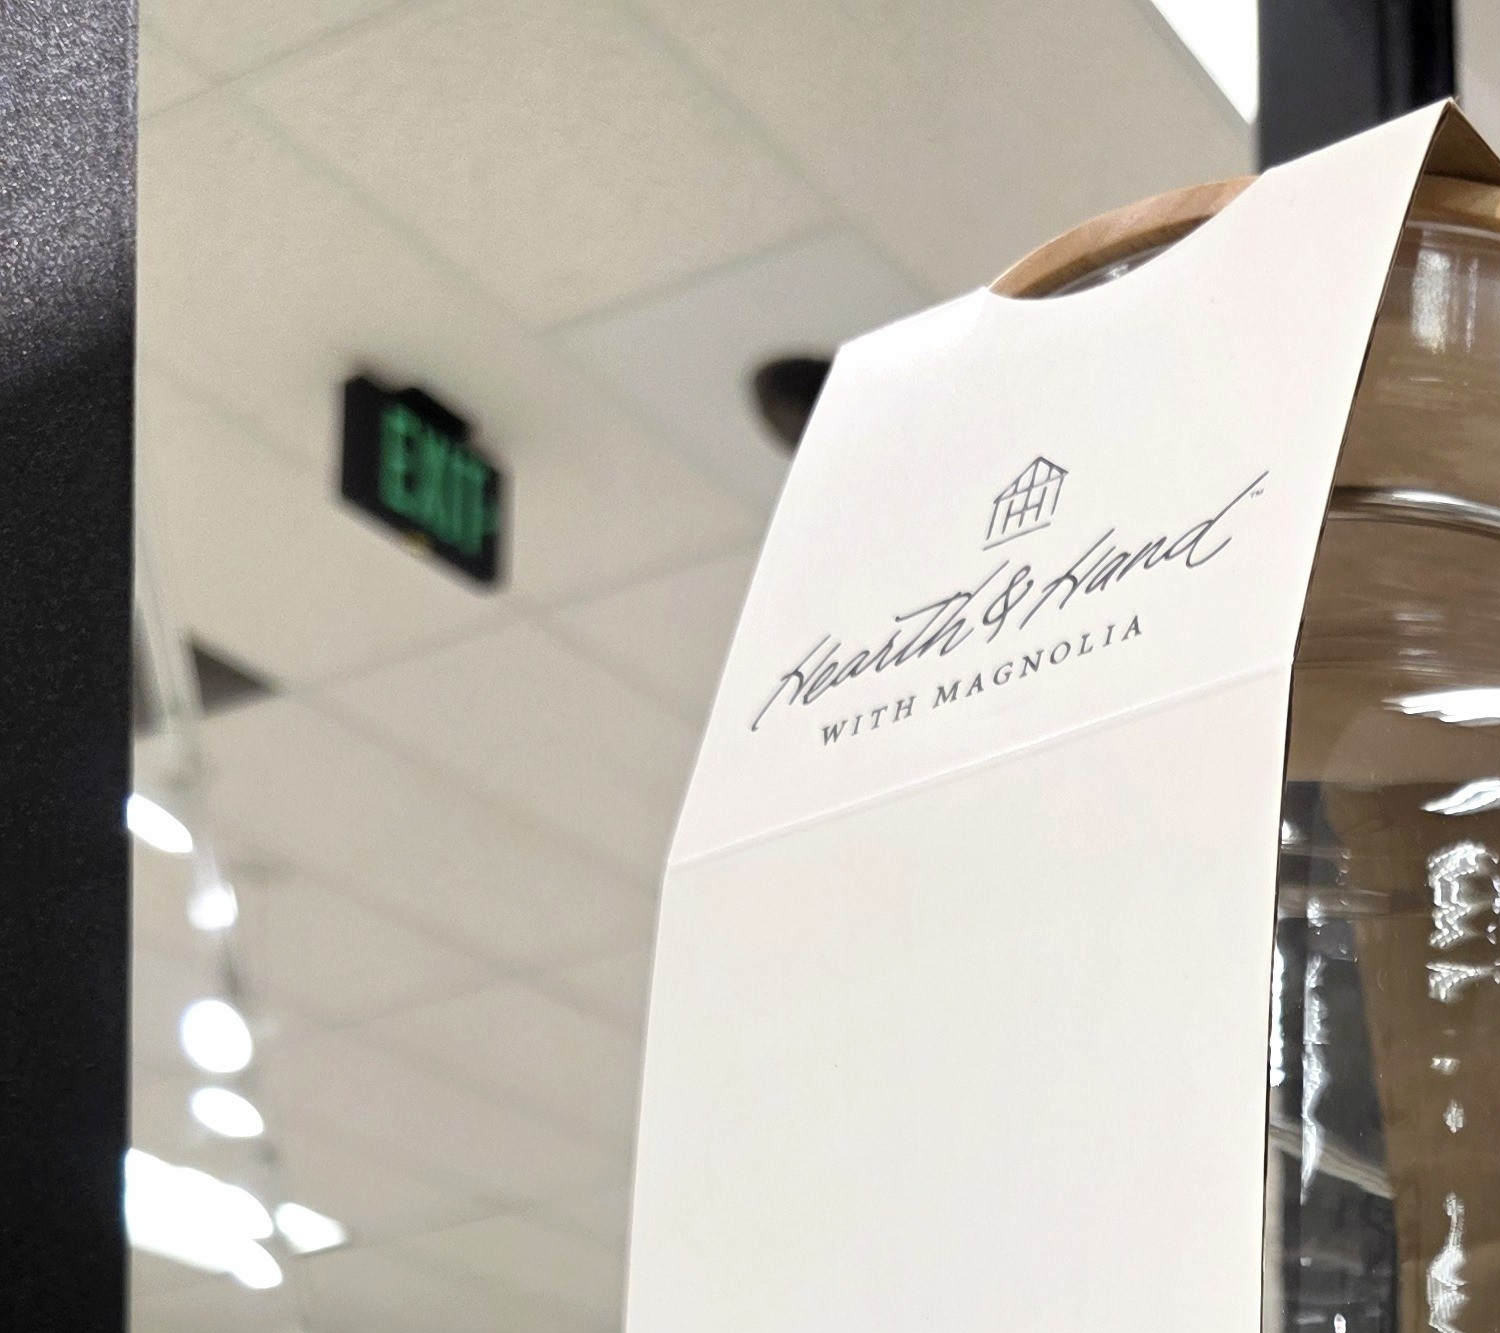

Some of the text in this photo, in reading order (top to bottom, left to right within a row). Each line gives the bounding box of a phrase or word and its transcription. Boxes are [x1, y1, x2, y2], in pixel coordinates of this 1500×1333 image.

[378, 402, 490, 556] EXIT
[751, 560, 1009, 732] Hearth
[982, 564, 1033, 643] &
[820, 615, 1144, 747] WITH MAGNOLIA
